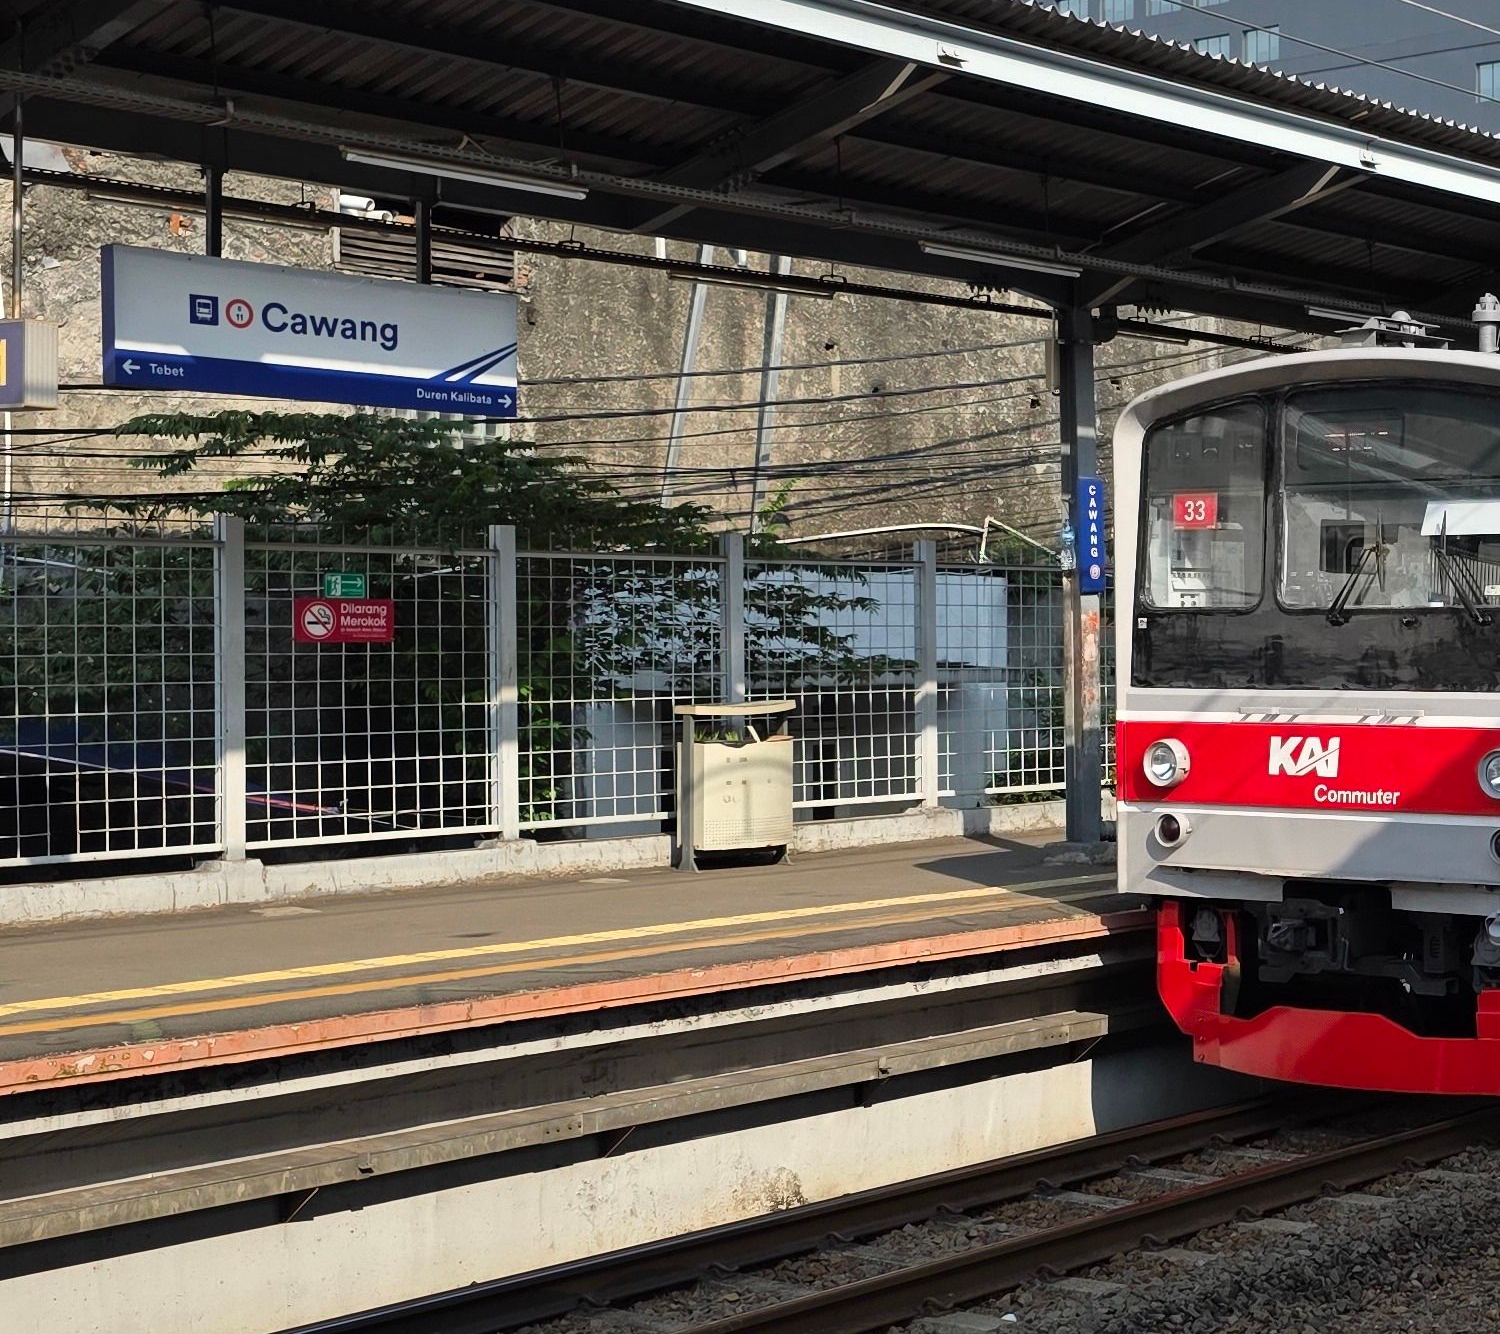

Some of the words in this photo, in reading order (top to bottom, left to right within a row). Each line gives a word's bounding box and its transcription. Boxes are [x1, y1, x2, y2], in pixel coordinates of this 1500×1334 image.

[261, 302, 398, 351] Cawang
[149, 363, 184, 377] Tebet
[416, 388, 448, 401] Duren
[450, 391, 492, 405] Kalibata
[1088, 485, 1099, 557] CAWANG
[1184, 500, 1206, 522] 33
[340, 603, 387, 616] Dilarang
[340, 615, 387, 627] Merokok
[1268, 735, 1341, 778] KAI
[1314, 784, 1401, 805] Commuter
